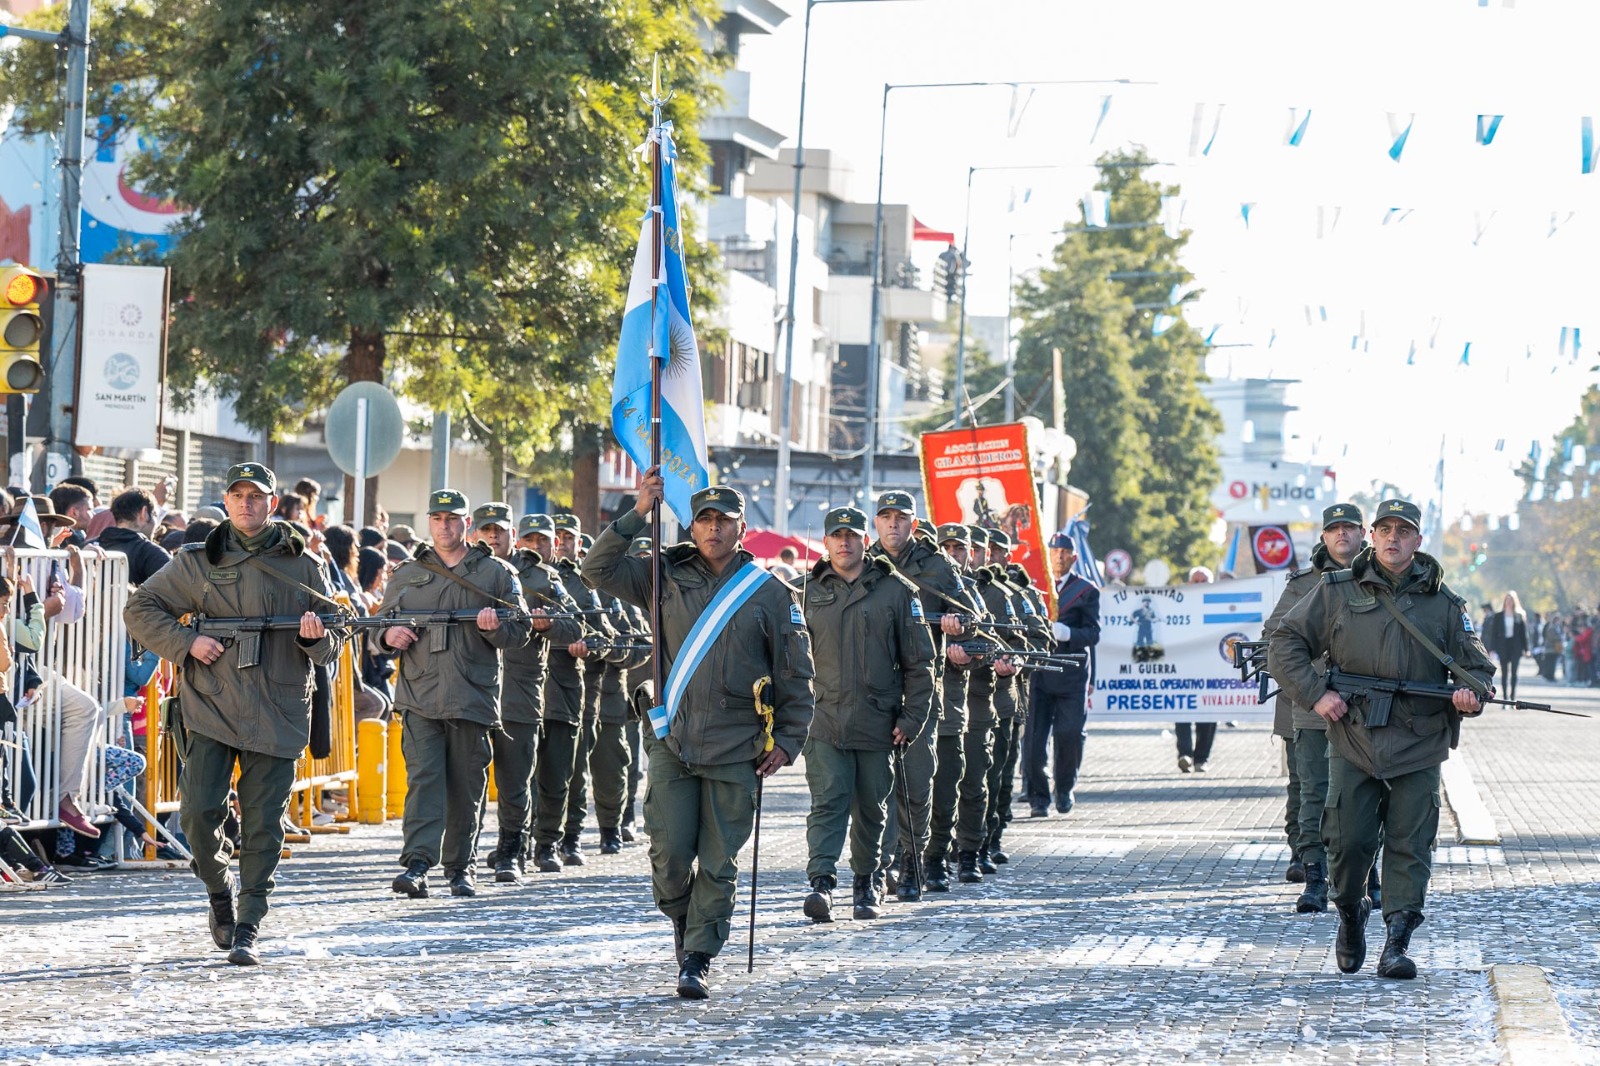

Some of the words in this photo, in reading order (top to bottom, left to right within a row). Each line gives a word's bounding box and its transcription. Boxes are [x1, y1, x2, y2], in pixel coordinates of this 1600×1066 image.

[95, 393, 112, 401] SAN
[114, 393, 147, 403] MARTÍN
[934, 449, 1022, 469] GRANADEROS
[1113, 589, 1128, 604] TU
[1104, 615, 1128, 627] 1975
[1166, 615, 1191, 626] 2025
[1119, 664, 1132, 674] MI
[1138, 664, 1177, 674] GUERRA
[1096, 679, 1108, 690] LA
[1108, 678, 1142, 690] GUERRA
[1143, 678, 1158, 690] DEL
[1106, 694, 1198, 710] PRESENTE
[1202, 695, 1222, 706] VIVA
[1224, 695, 1235, 706] LA
